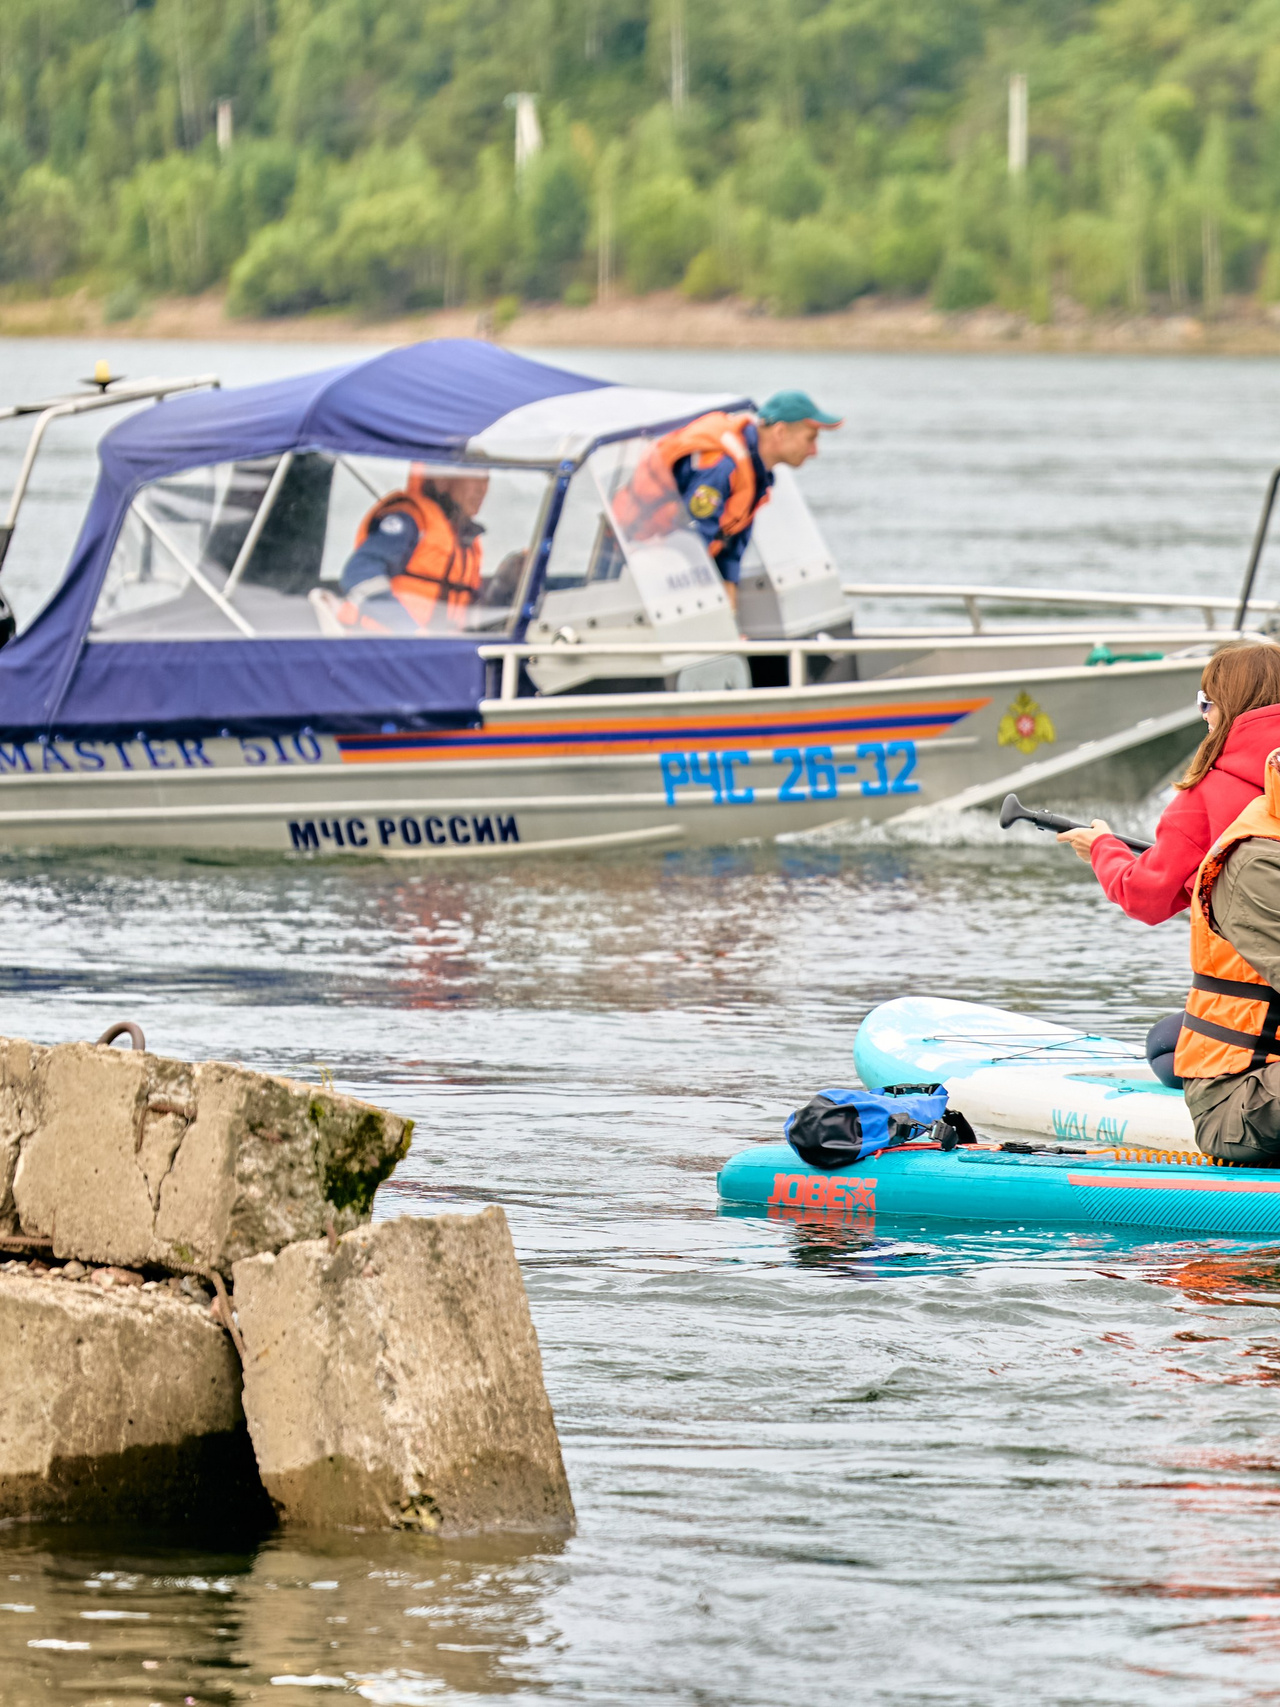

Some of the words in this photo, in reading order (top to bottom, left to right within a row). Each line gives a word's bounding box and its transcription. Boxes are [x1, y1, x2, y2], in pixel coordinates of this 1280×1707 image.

[240, 734, 322, 766] 510
[659, 750, 754, 806] РЧС
[773, 741, 920, 802] 26-32
[288, 817, 368, 849] МЧС
[376, 814, 520, 846] РОССИИ
[767, 1173, 849, 1210] JOBE
